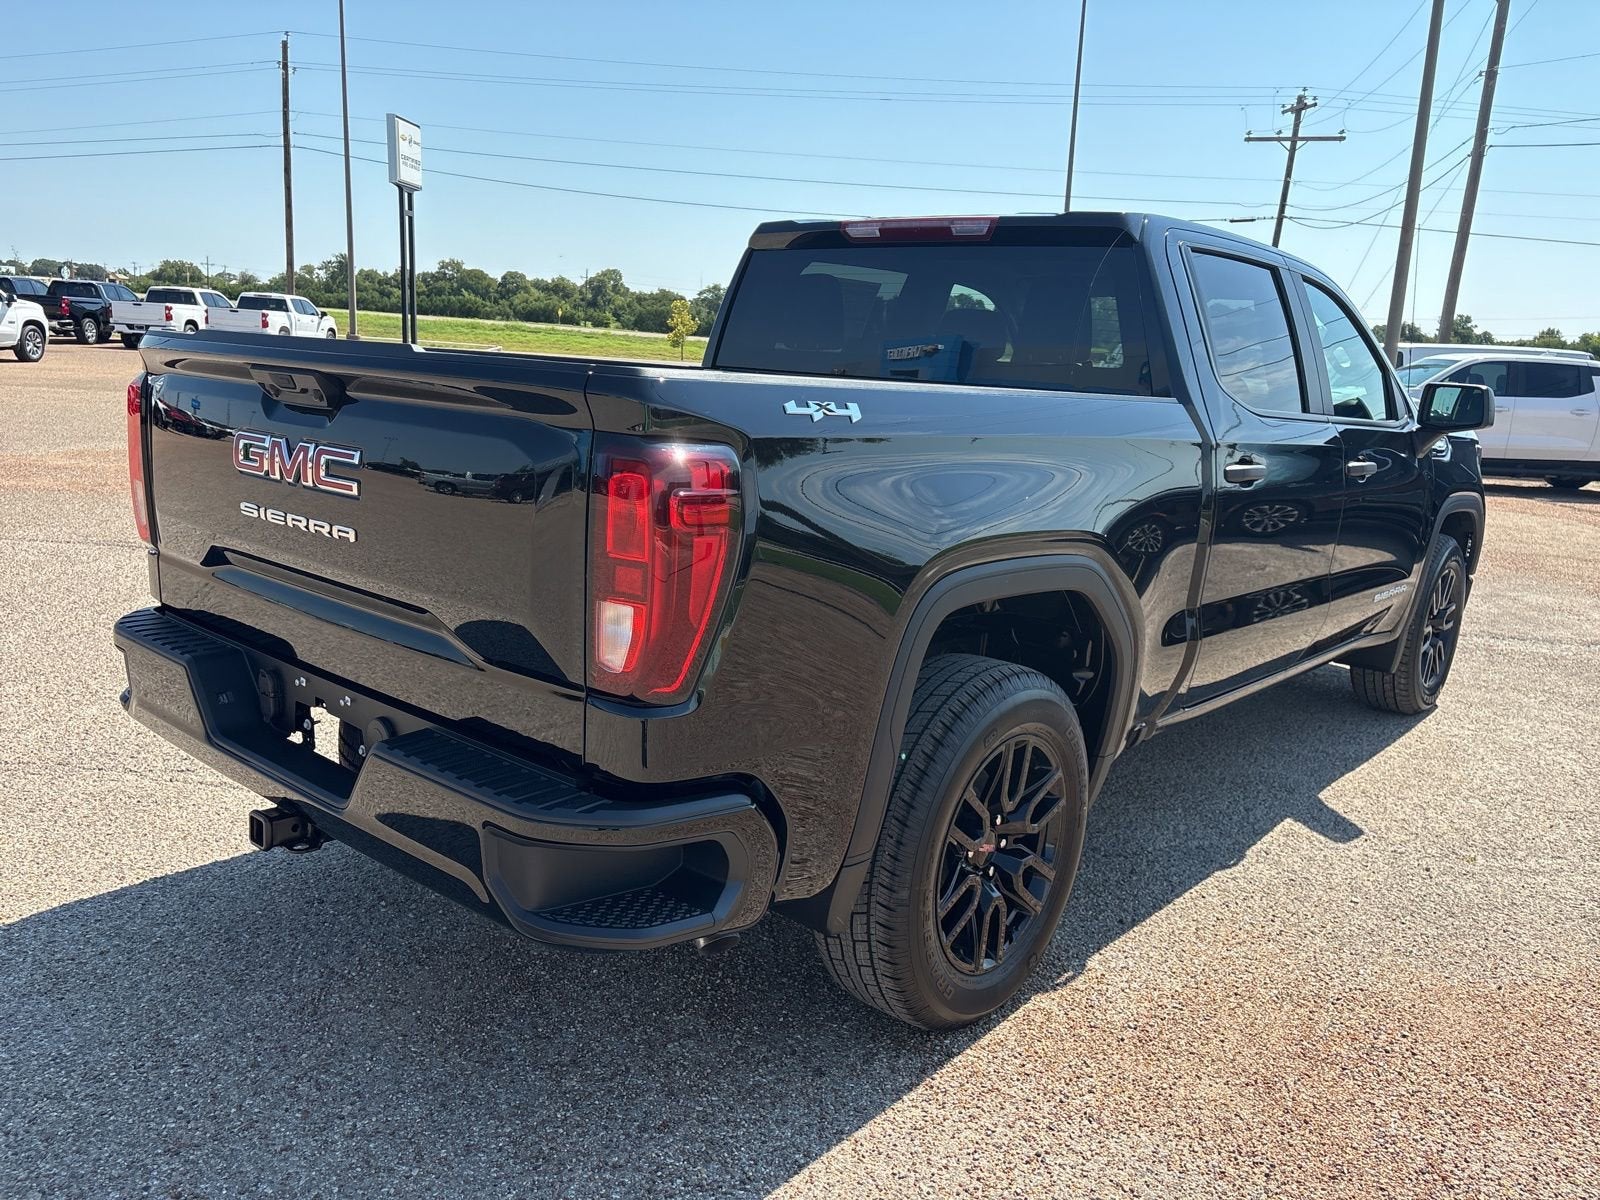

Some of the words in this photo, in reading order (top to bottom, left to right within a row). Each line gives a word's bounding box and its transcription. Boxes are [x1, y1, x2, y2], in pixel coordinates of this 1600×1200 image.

[232, 430, 363, 499] GMC
[239, 501, 358, 544] SIERRA
[1374, 584, 1409, 603] SIERRA
